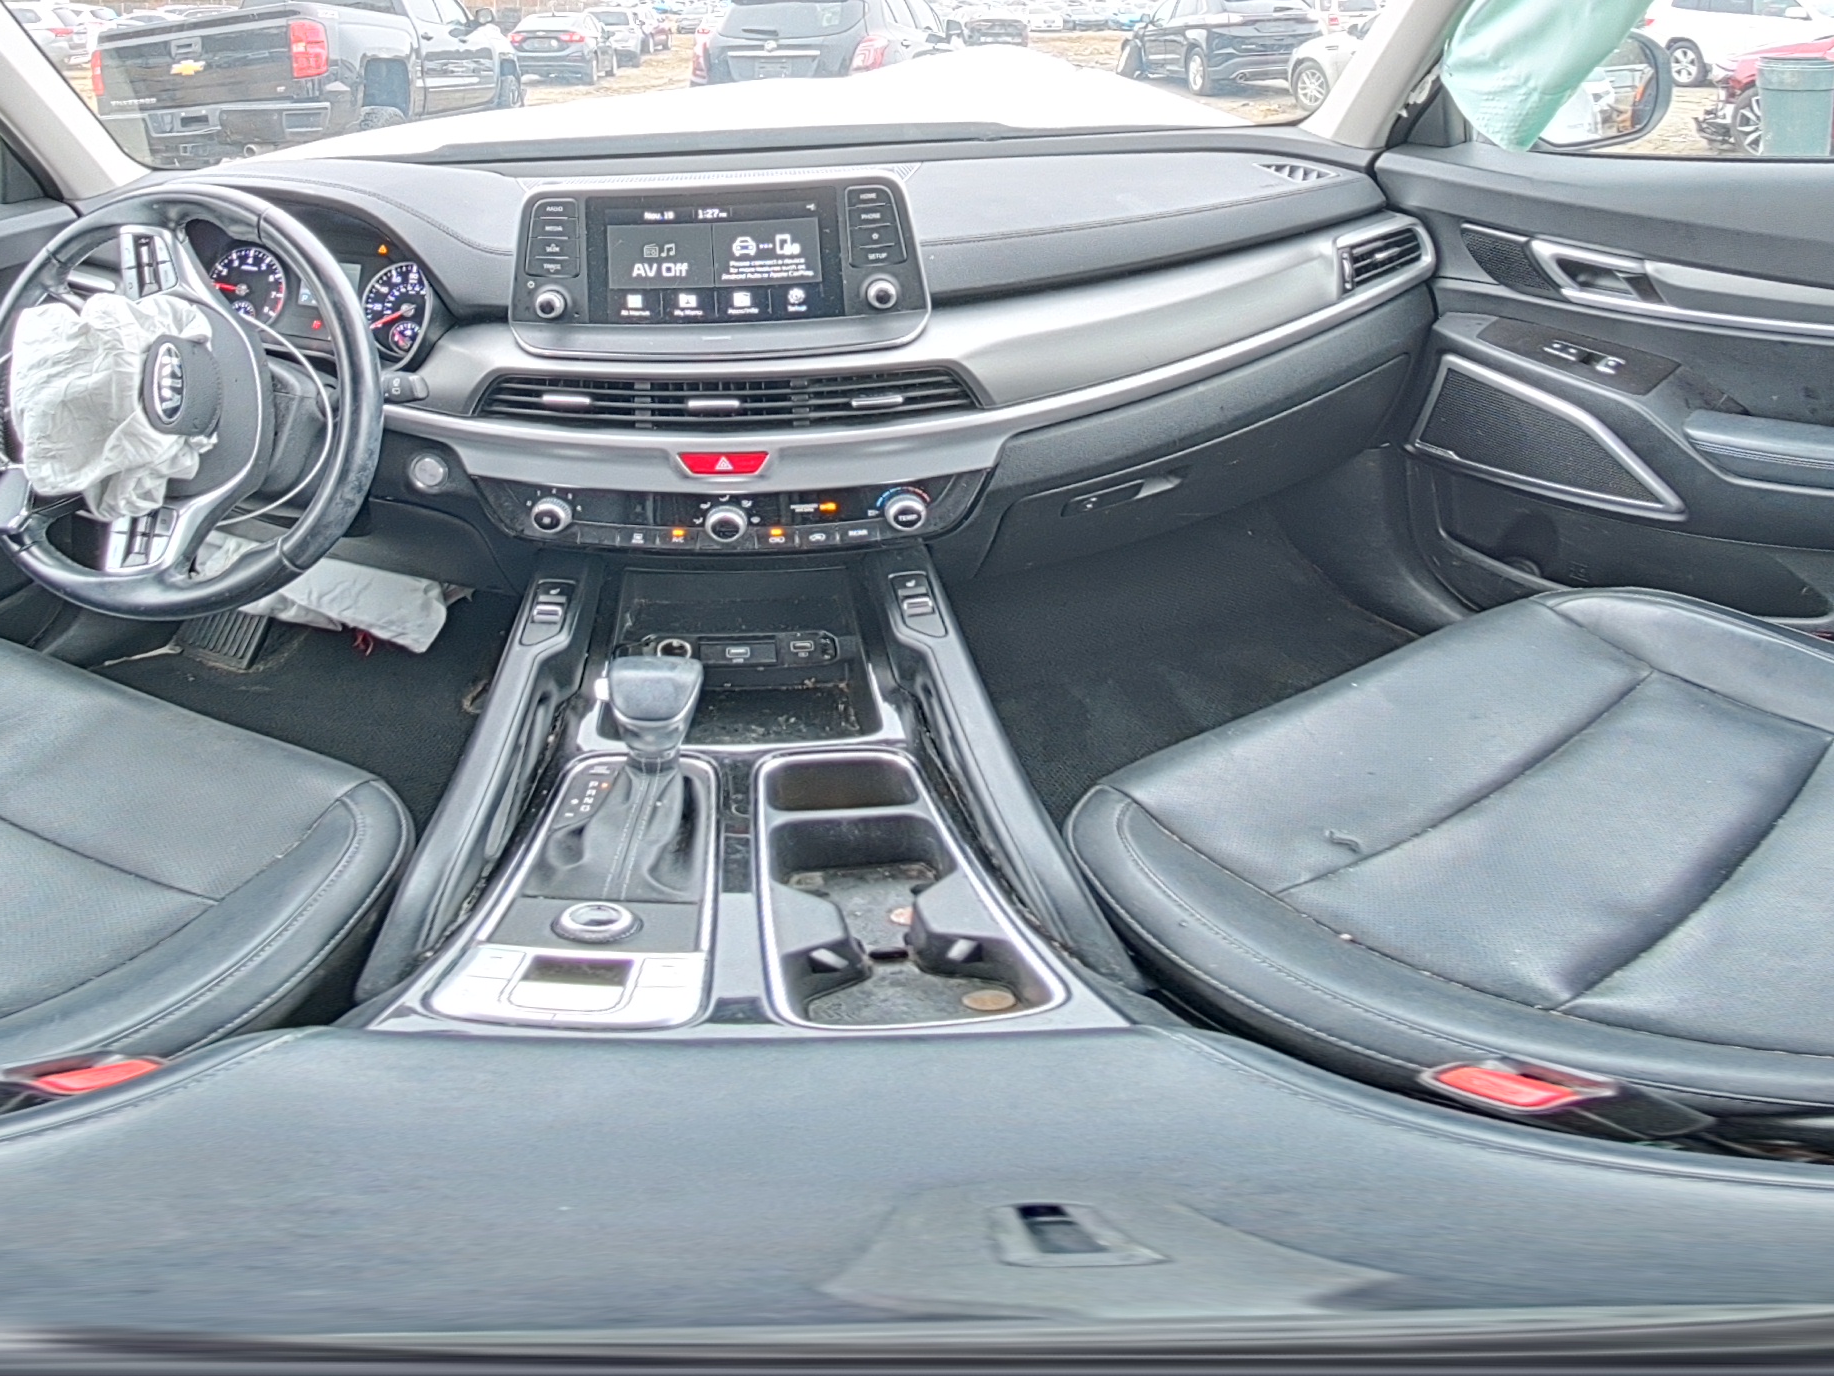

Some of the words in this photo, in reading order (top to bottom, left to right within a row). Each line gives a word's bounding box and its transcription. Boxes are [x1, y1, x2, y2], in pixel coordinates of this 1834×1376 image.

[697, 209, 719, 219] 1:27
[632, 263, 658, 277] AV
[662, 262, 688, 277] Off
[898, 514, 918, 522] TEMP
